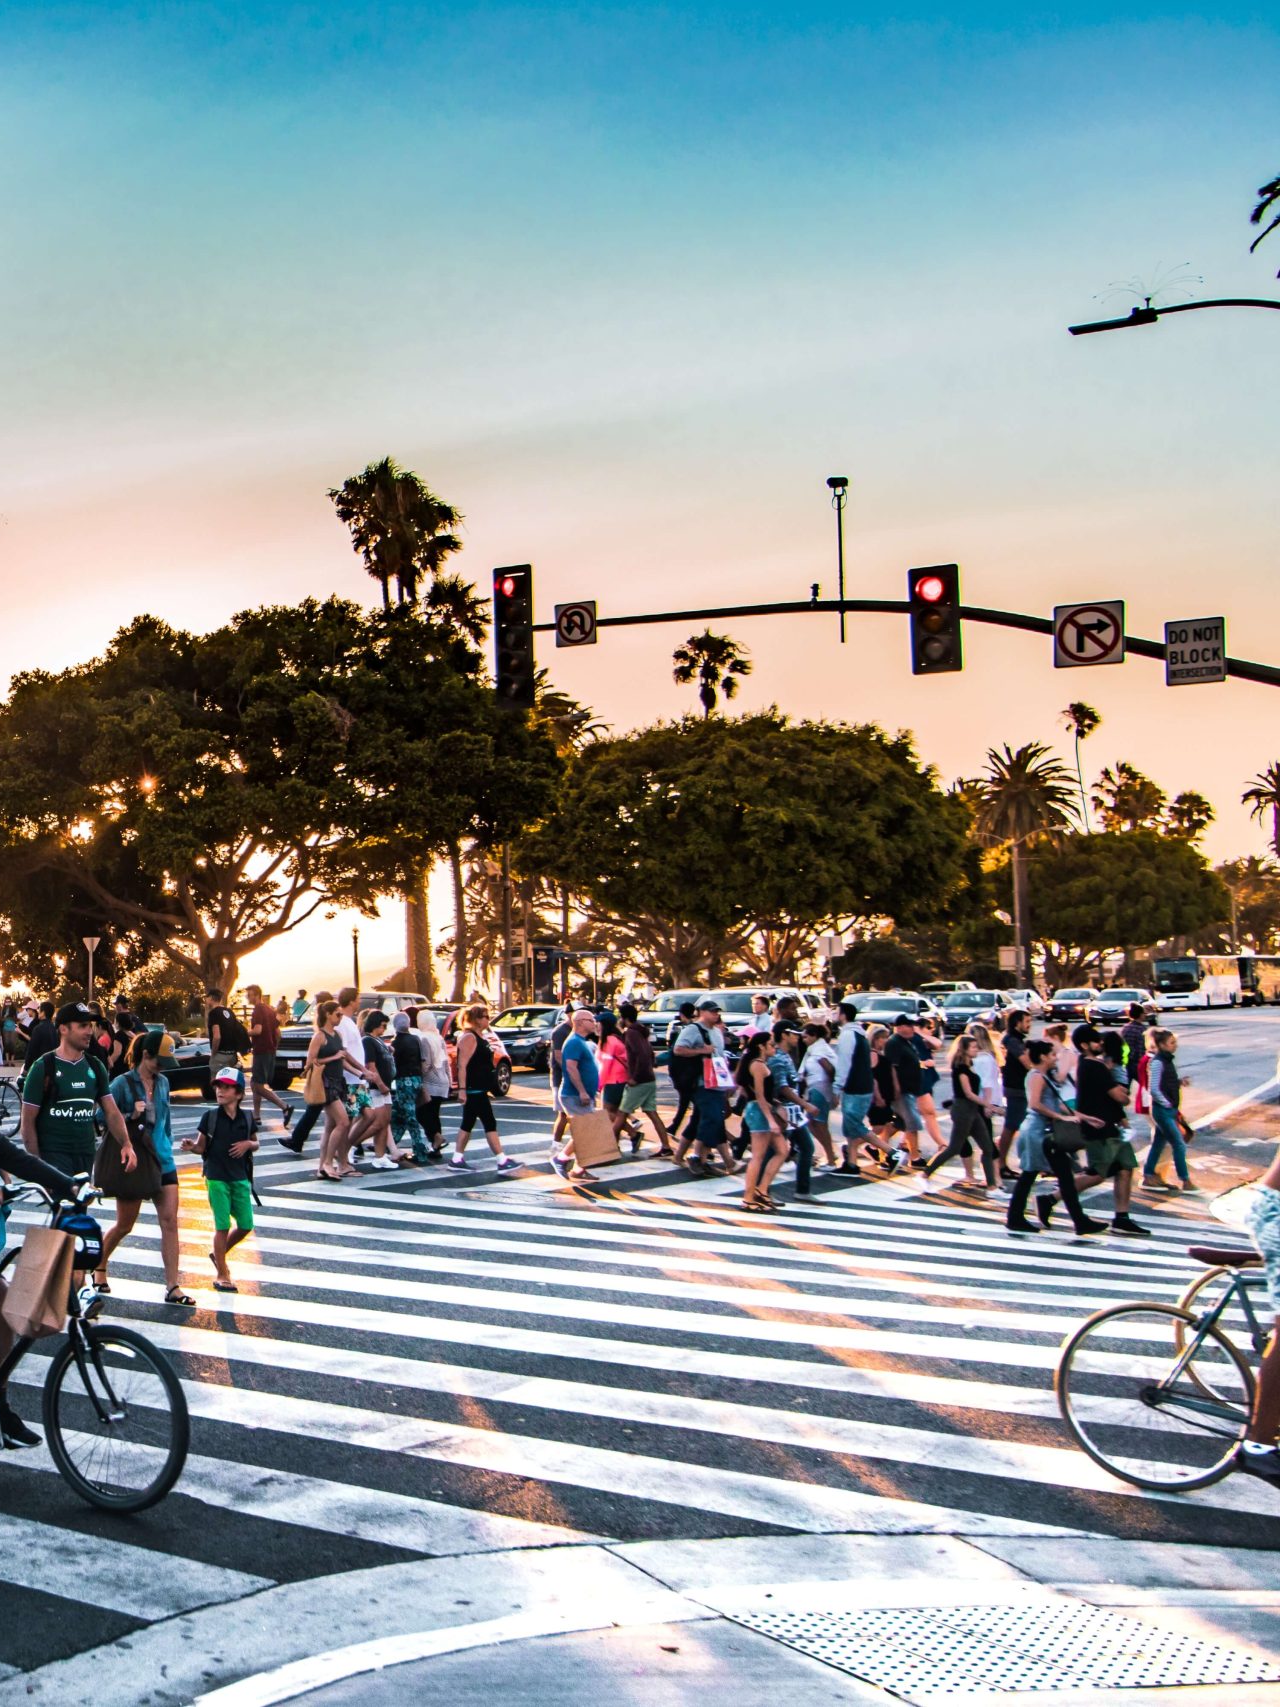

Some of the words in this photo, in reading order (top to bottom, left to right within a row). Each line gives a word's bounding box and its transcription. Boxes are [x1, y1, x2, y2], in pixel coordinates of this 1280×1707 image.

[1168, 629, 1188, 644] DO
[1193, 626, 1220, 642] NOT
[1169, 647, 1221, 665] BLOCK
